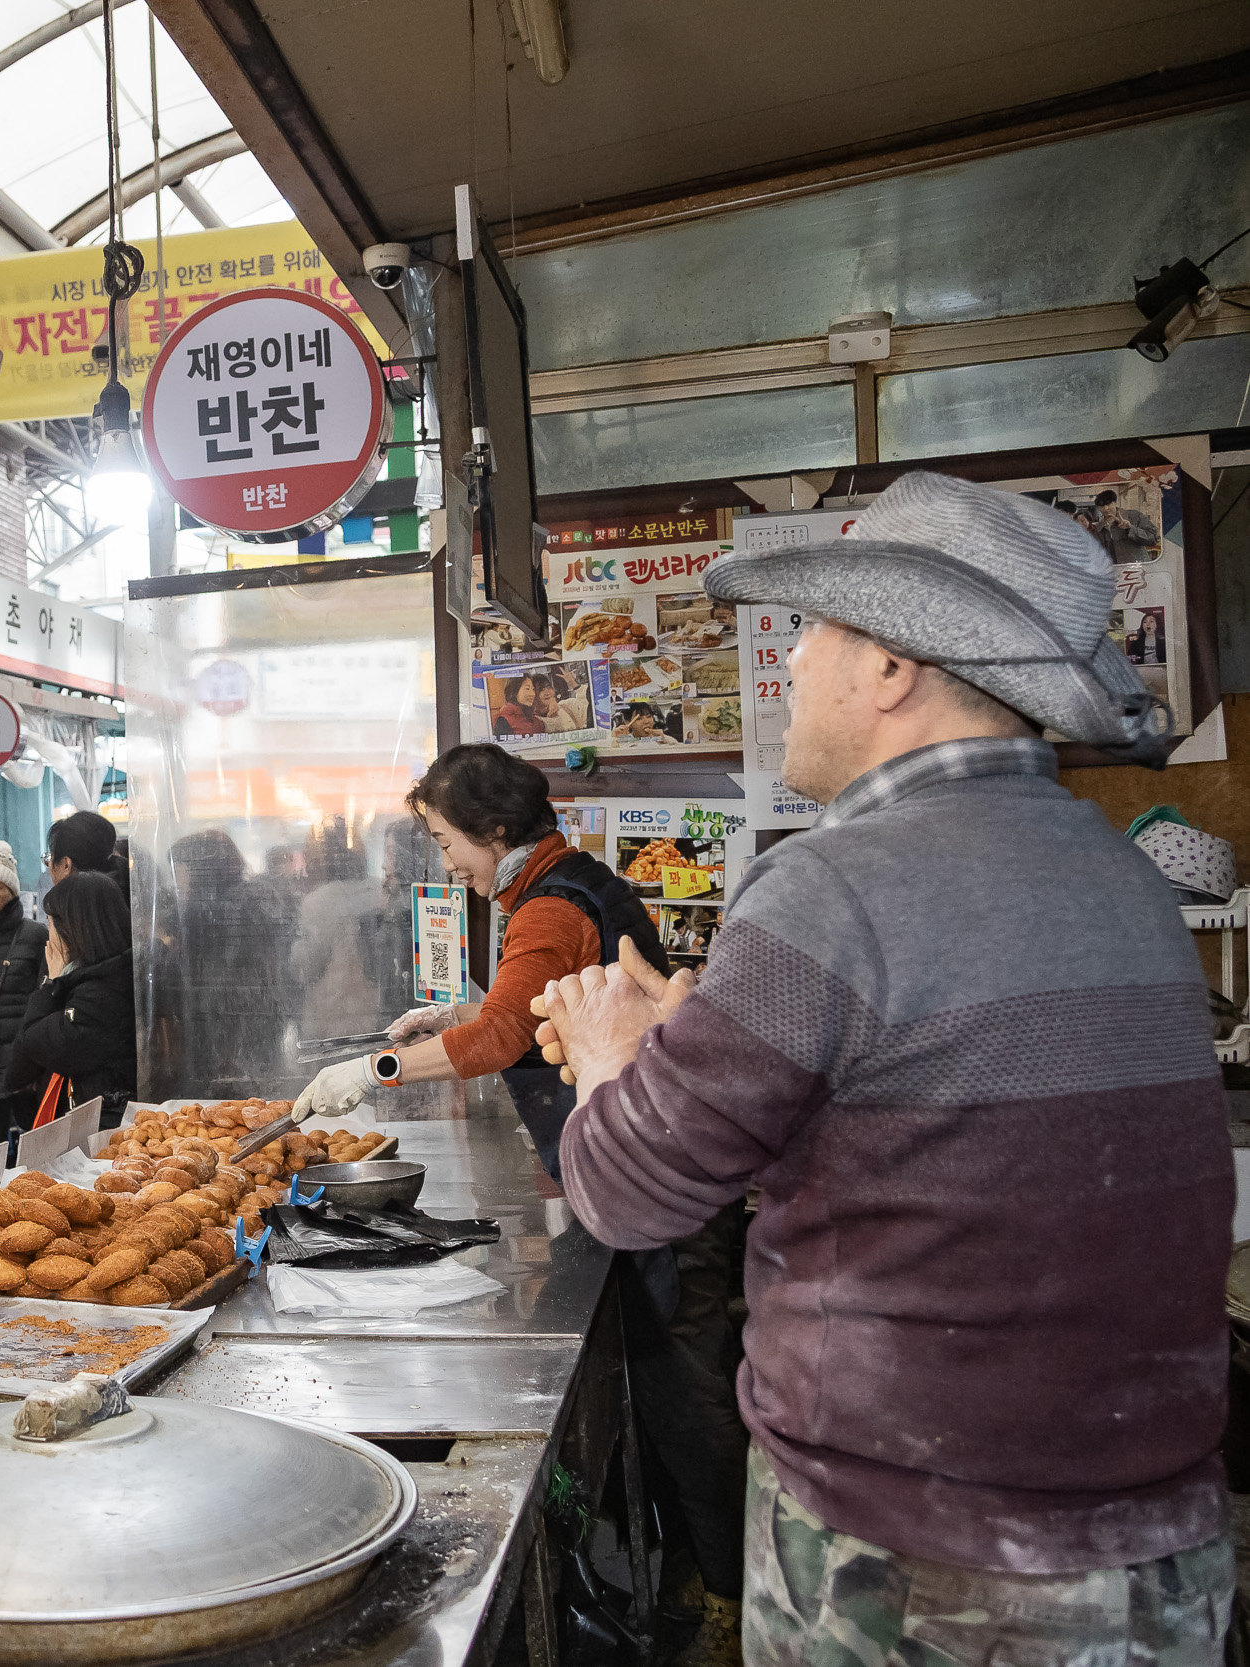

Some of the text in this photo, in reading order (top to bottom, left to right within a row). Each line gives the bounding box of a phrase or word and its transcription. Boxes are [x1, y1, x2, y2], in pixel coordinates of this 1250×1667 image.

[51, 279, 87, 302] 시장
[176, 263, 213, 287] 안전
[220, 254, 276, 279] 확보를
[284, 249, 321, 271] 위해
[186, 327, 332, 382] 재영이네
[197, 383, 326, 463] 반찬
[242, 483, 288, 512] 반찬
[760, 613, 802, 631] 8 9
[756, 648, 778, 665] 15
[756, 681, 781, 698] 22
[619, 810, 654, 823] KBS
